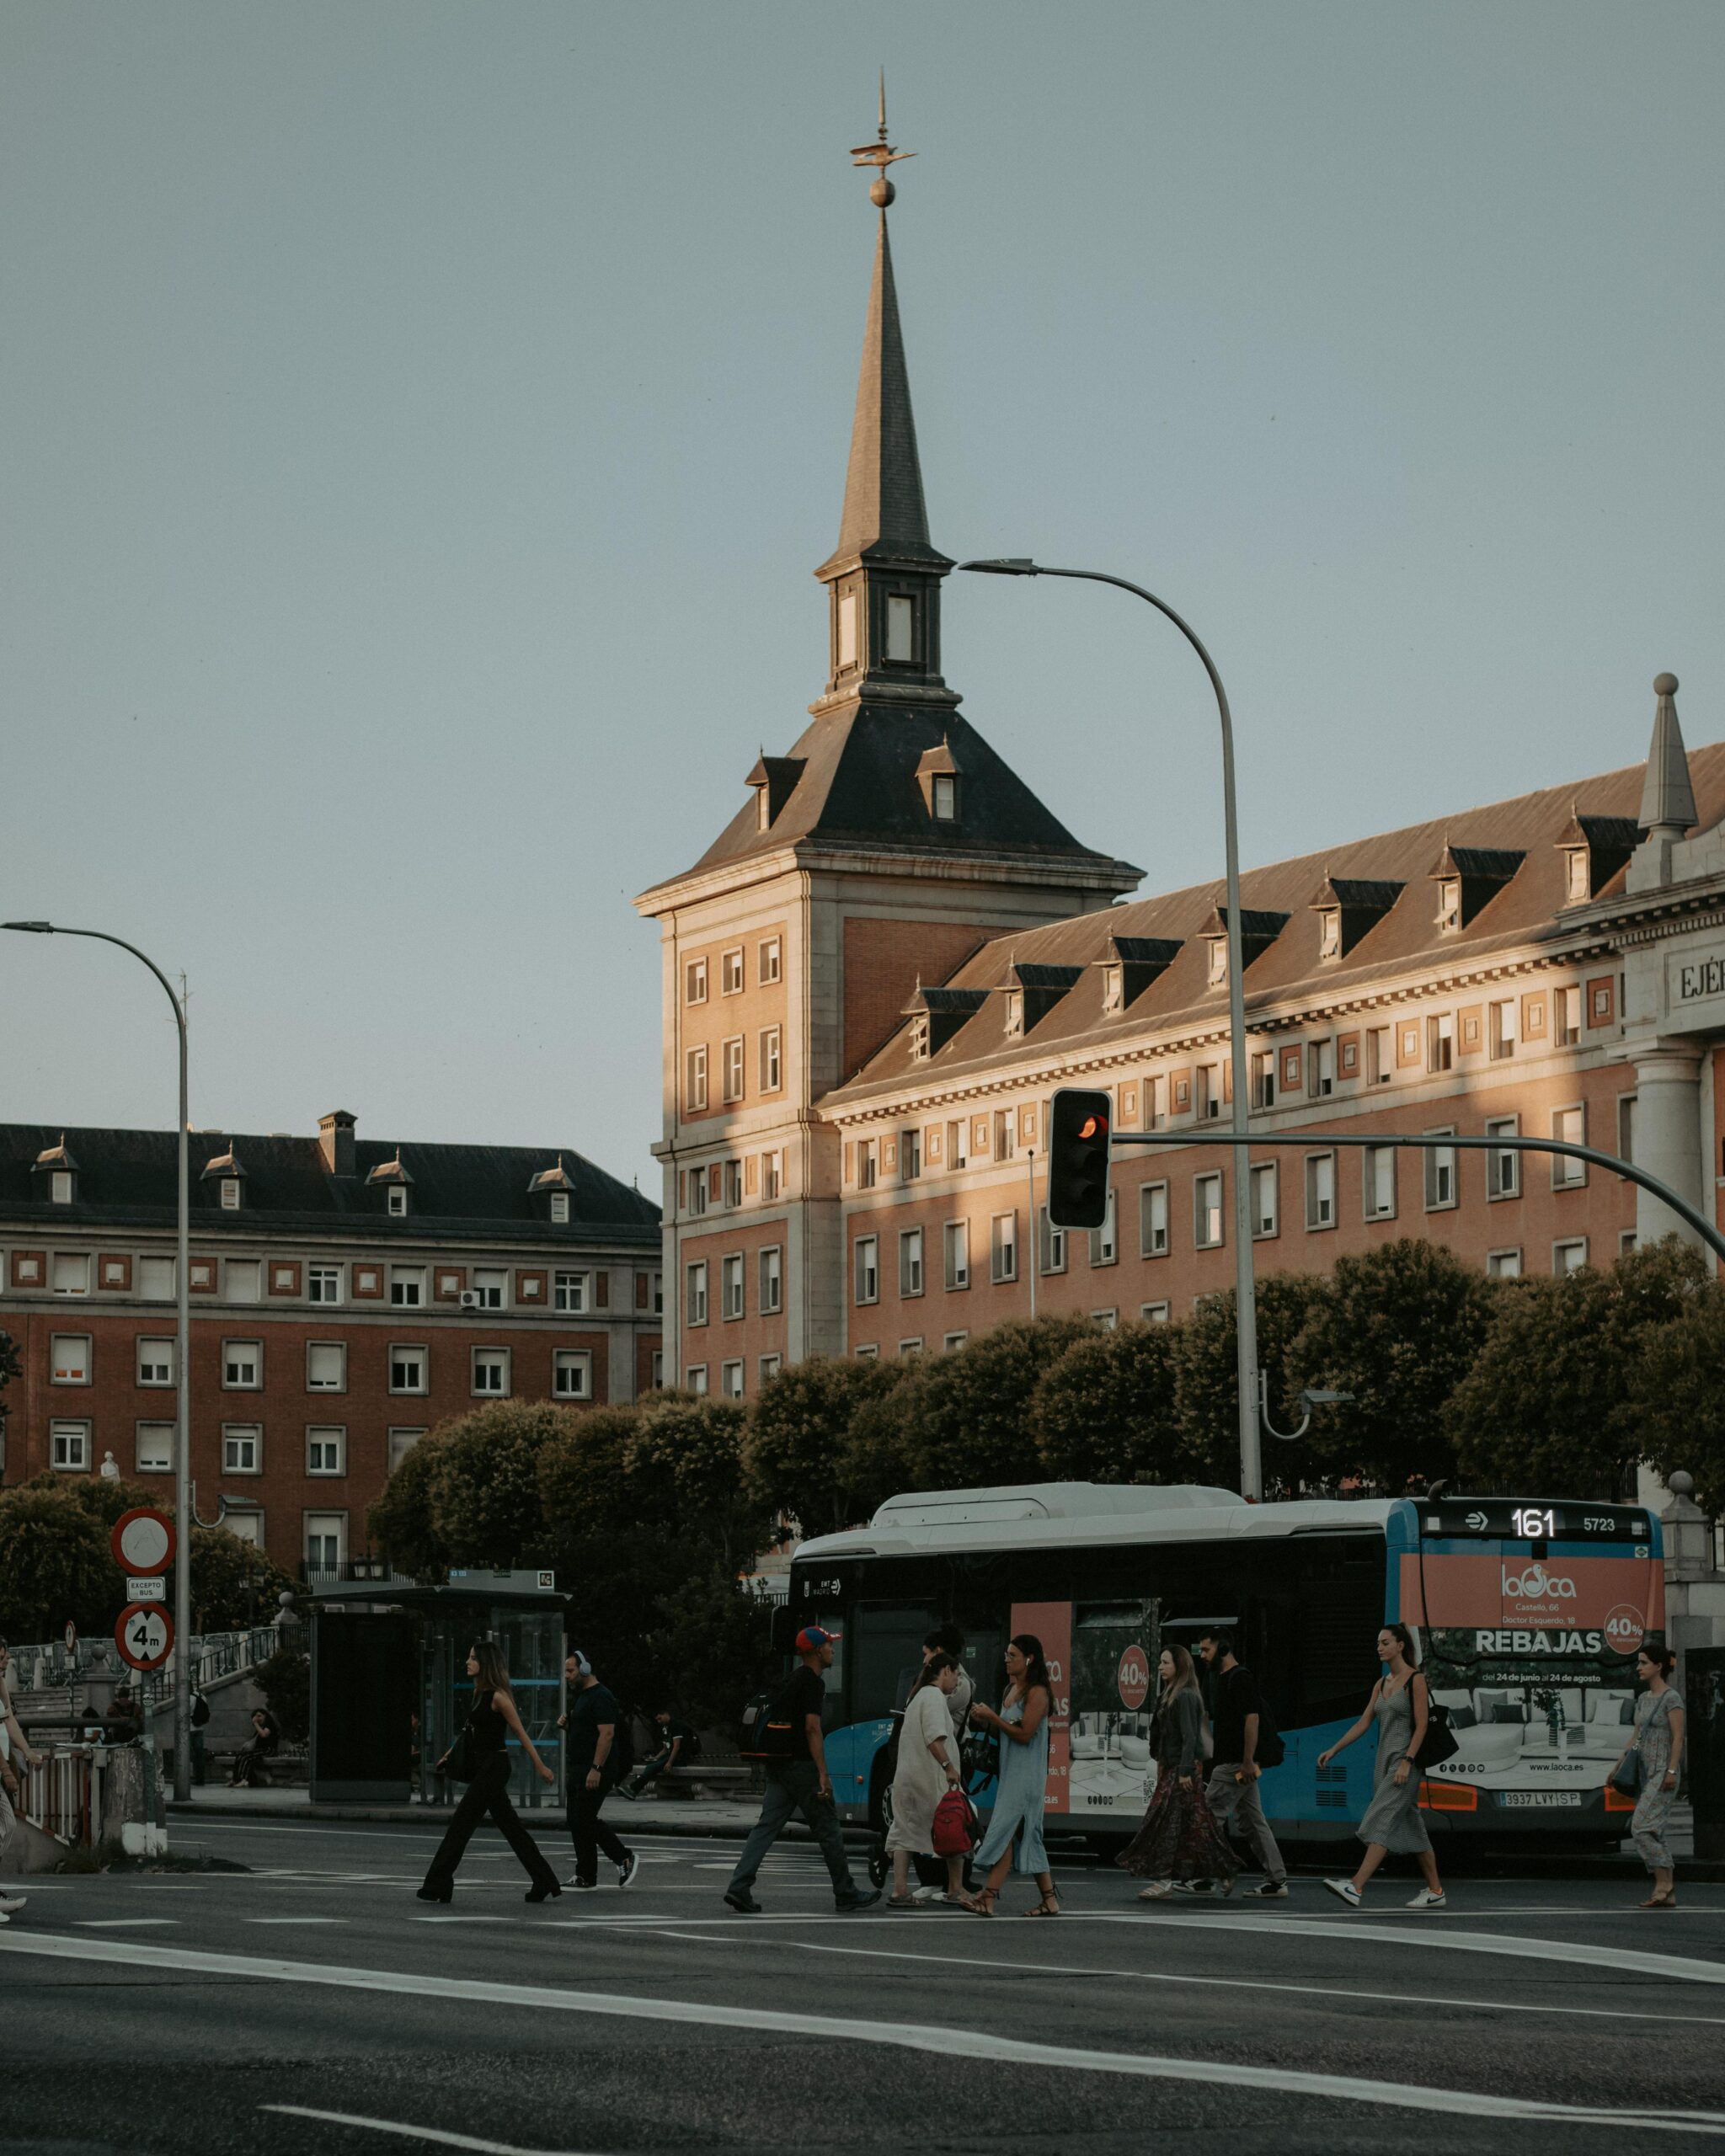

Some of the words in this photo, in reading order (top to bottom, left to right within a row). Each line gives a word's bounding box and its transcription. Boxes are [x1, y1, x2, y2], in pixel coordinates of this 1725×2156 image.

[1511, 1508, 1555, 1537] 161
[1583, 1518, 1616, 1531] 5723
[1606, 1617, 1643, 1636] 40%
[1476, 1630, 1602, 1653] REBAJAS
[1120, 1662, 1147, 1685] 40%
[1482, 1673, 1495, 1681] del
[1496, 1673, 1508, 1681] 24
[1519, 1673, 1541, 1683] junio
[1550, 1673, 1561, 1682] 24
[1562, 1673, 1573, 1682] de
[1573, 1675, 1601, 1684] agosto
[1530, 1763, 1584, 1771] www.laoca.es
[1507, 1794, 1531, 1805] 3937
[1535, 1794, 1553, 1805] LVY
[1560, 1793, 1578, 1805] SP
